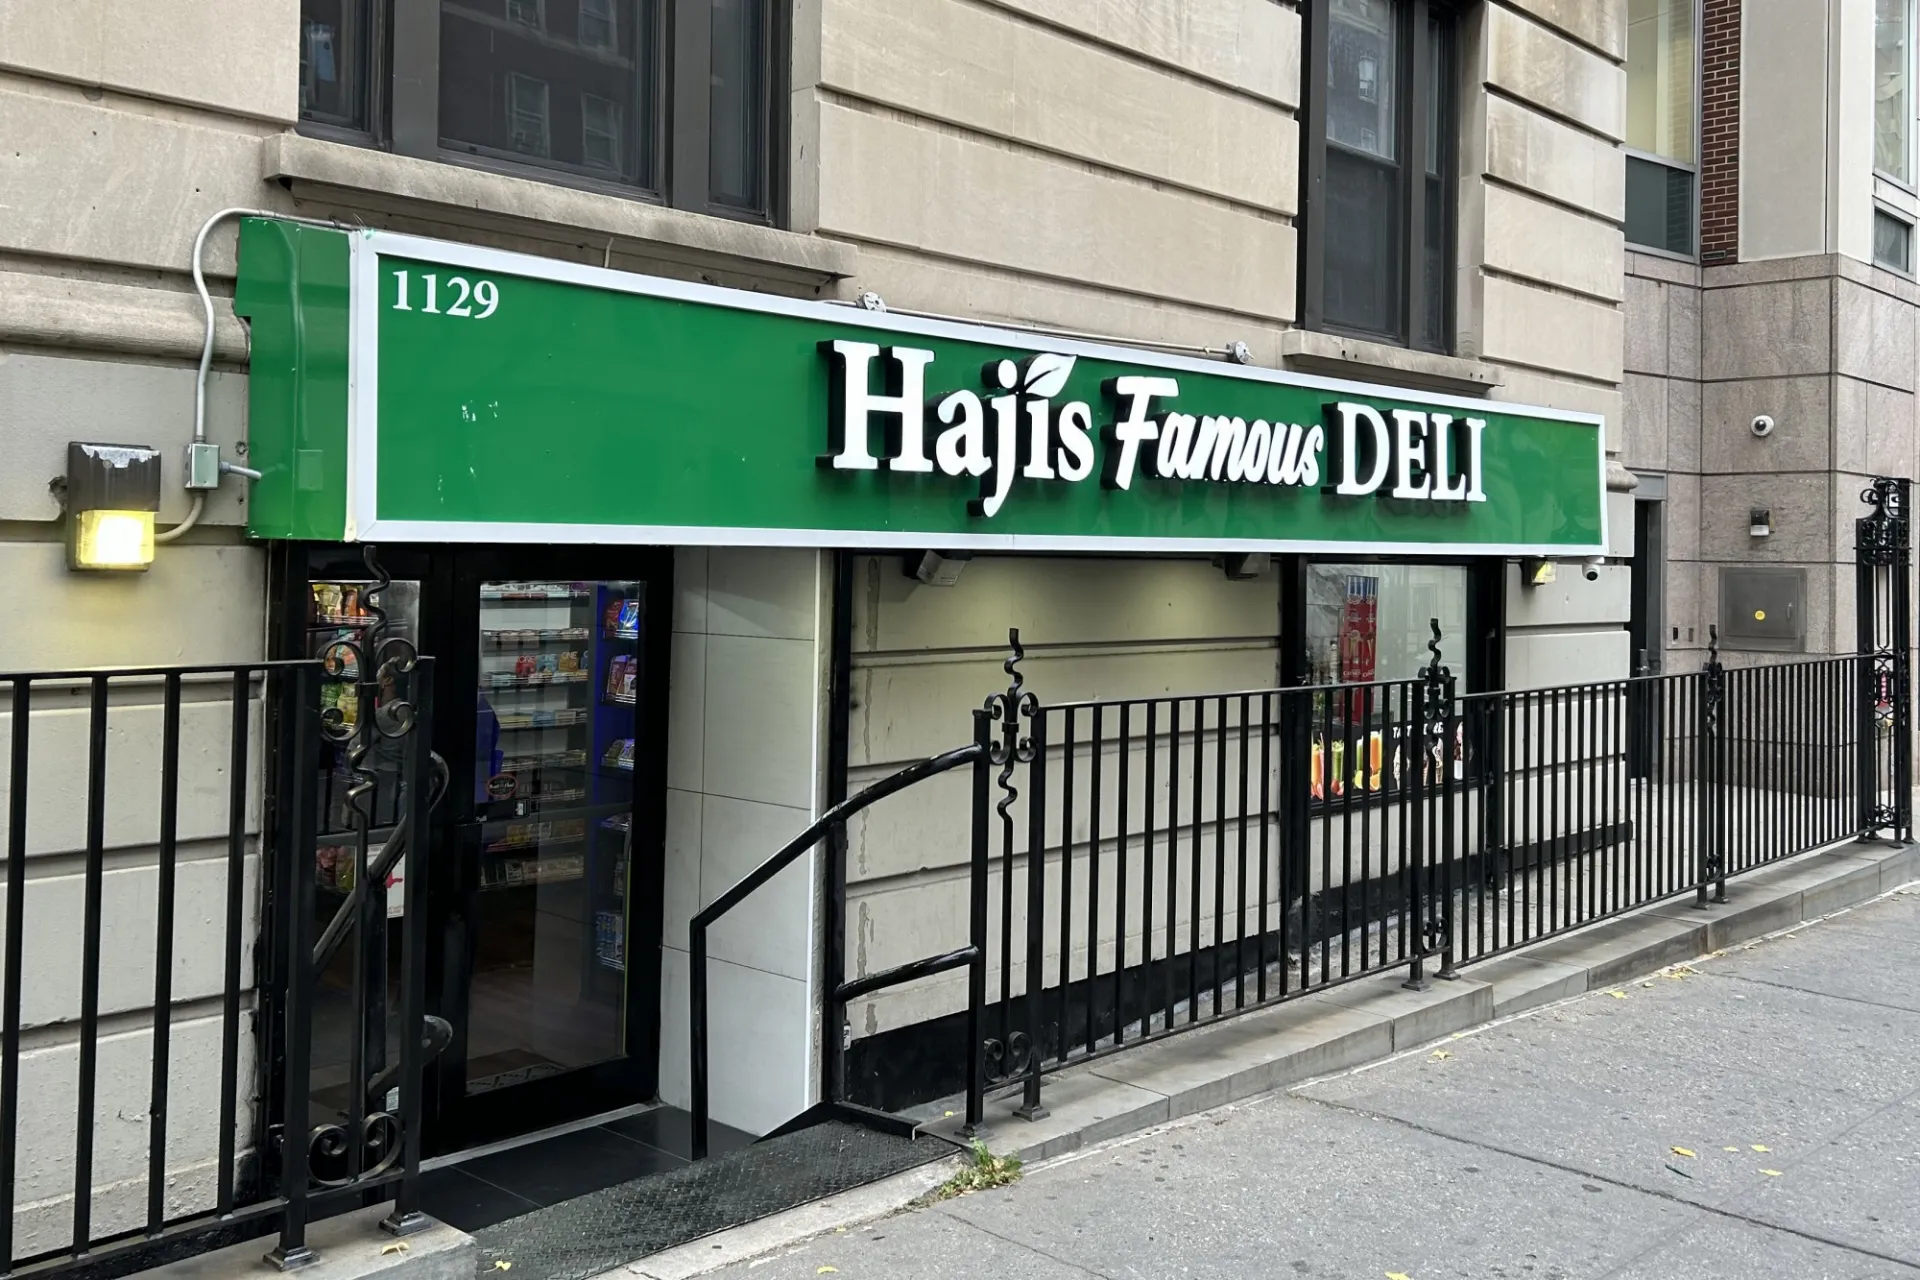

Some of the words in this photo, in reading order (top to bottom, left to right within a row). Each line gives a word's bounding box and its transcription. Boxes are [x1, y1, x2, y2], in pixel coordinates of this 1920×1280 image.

[393, 270, 500, 319] 1129
[1115, 376, 1324, 491] Famous
[1336, 402, 1487, 502] DELI
